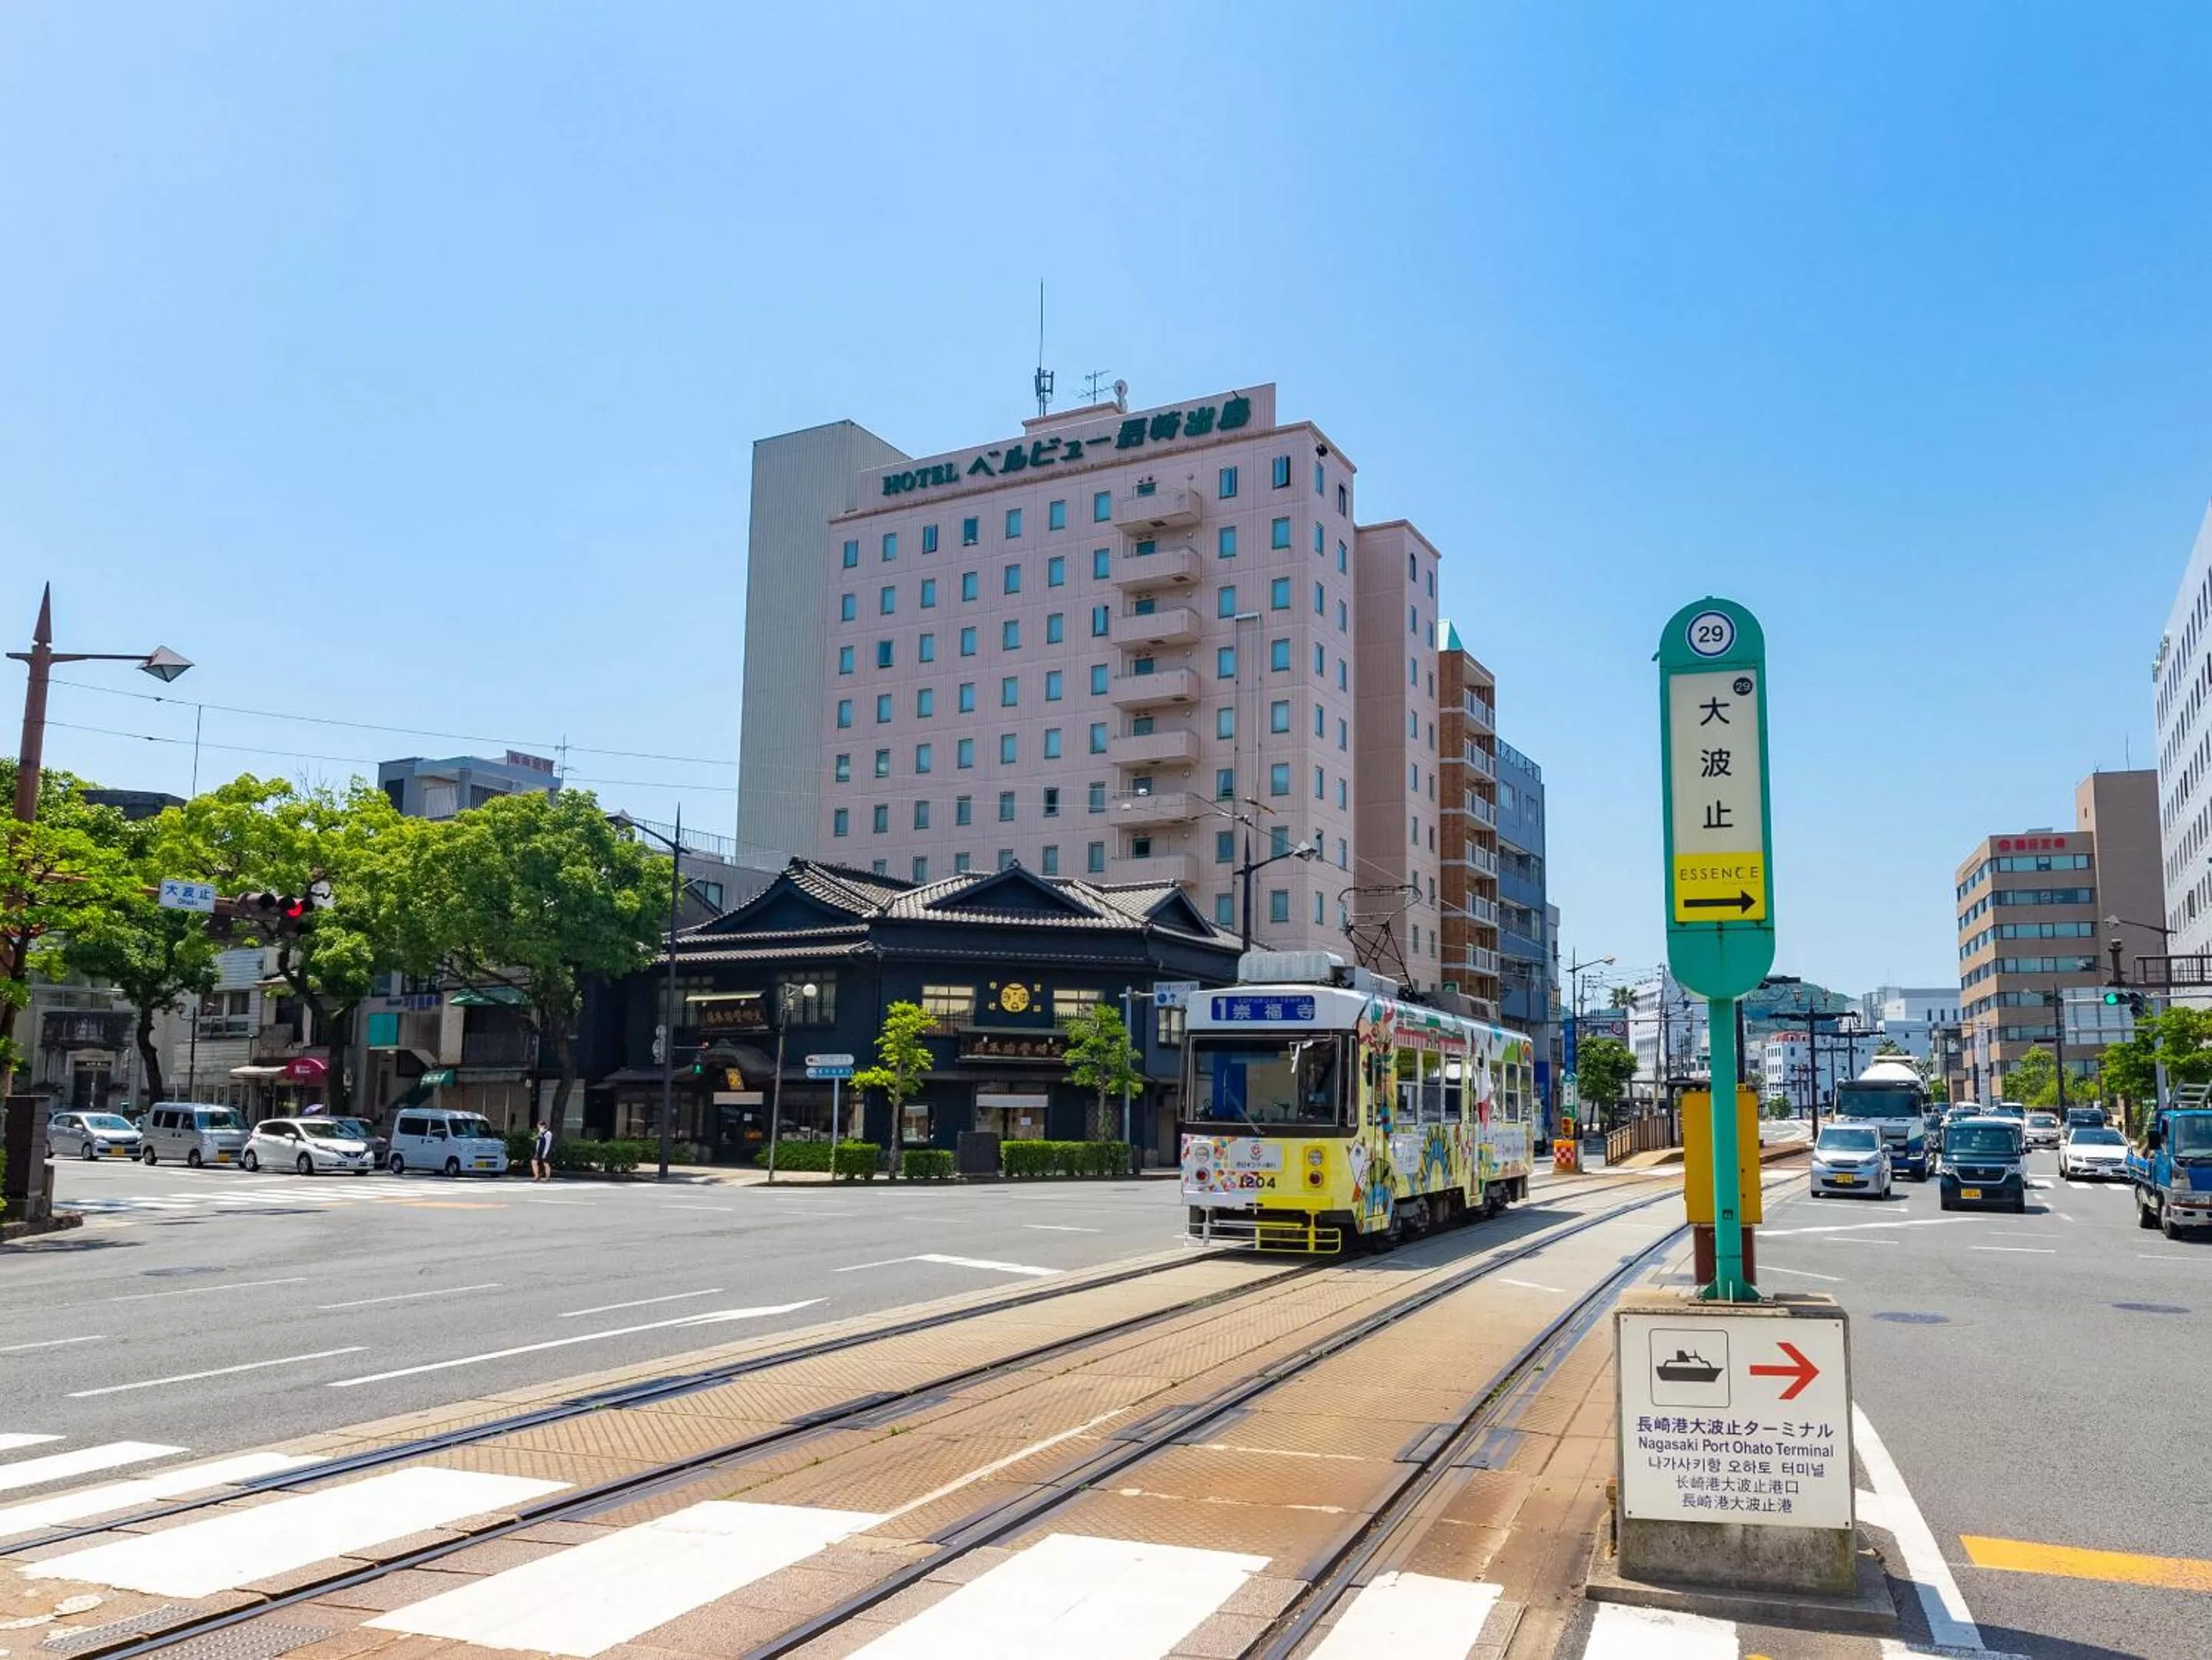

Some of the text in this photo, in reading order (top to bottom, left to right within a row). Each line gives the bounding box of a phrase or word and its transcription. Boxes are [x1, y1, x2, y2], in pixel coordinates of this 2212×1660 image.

[882, 462, 960, 496] HOTEL
[1698, 625, 1724, 643] 29
[1735, 681, 1751, 692] 29
[1700, 697, 1733, 829] 大波止
[1680, 866, 1759, 881] ESSENCE
[1217, 998, 1227, 1020] 1
[1239, 1176, 1276, 1188] 1204
[1637, 1416, 1833, 1439] 長崎港大波止ターミナル
[1639, 1436, 1834, 1457] Nagasaki Port Ohato Terminal
[1648, 1456, 1825, 1477] 나가사키항 오하토 터미널
[1676, 1476, 1799, 1494] 长崎港大波止港口
[1681, 1493, 1792, 1513] 長崎港大波止港
